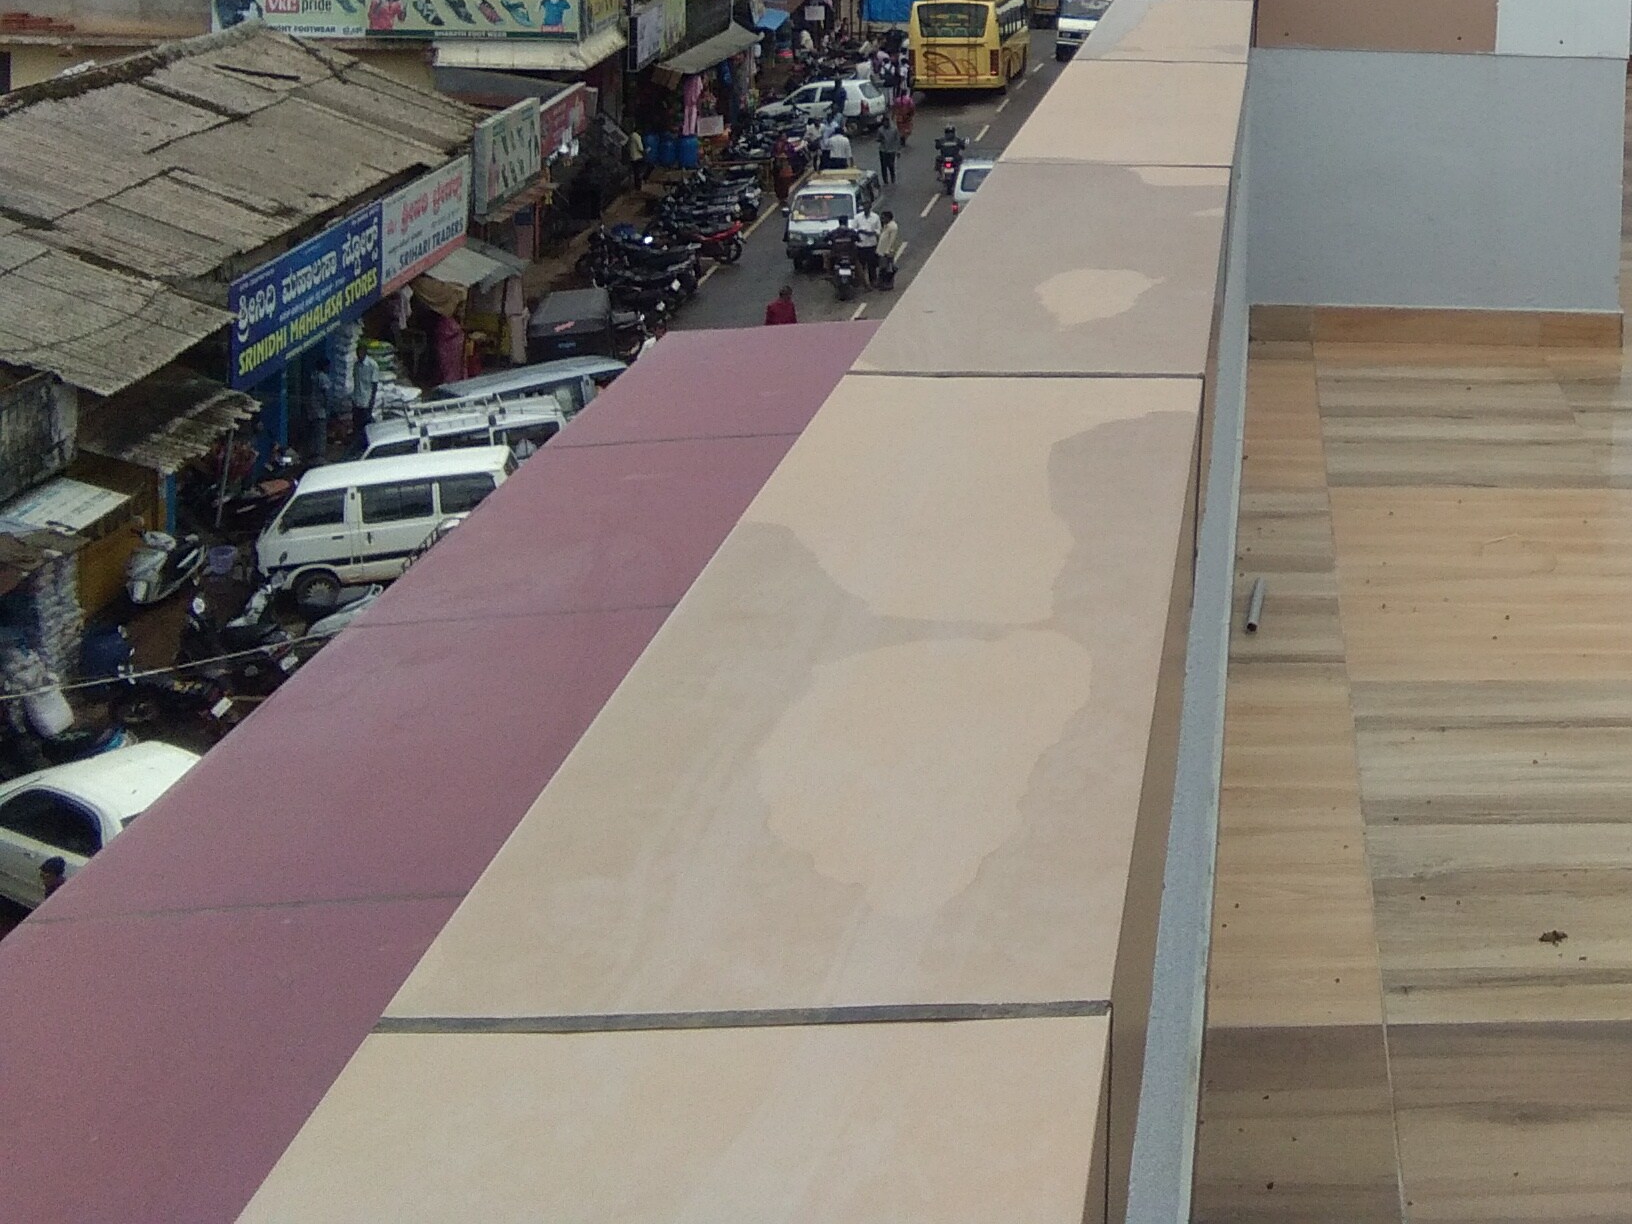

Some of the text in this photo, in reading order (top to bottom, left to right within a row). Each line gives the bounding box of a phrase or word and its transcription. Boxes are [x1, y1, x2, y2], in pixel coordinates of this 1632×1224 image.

[293, 25, 336, 33] FOOTWEAR
[400, 237, 431, 267] SRIHARI
[432, 216, 464, 249] TRADERS
[238, 326, 287, 376] SRINIDHI
[290, 291, 343, 343] MAHALASA
[344, 267, 378, 306] STORES
